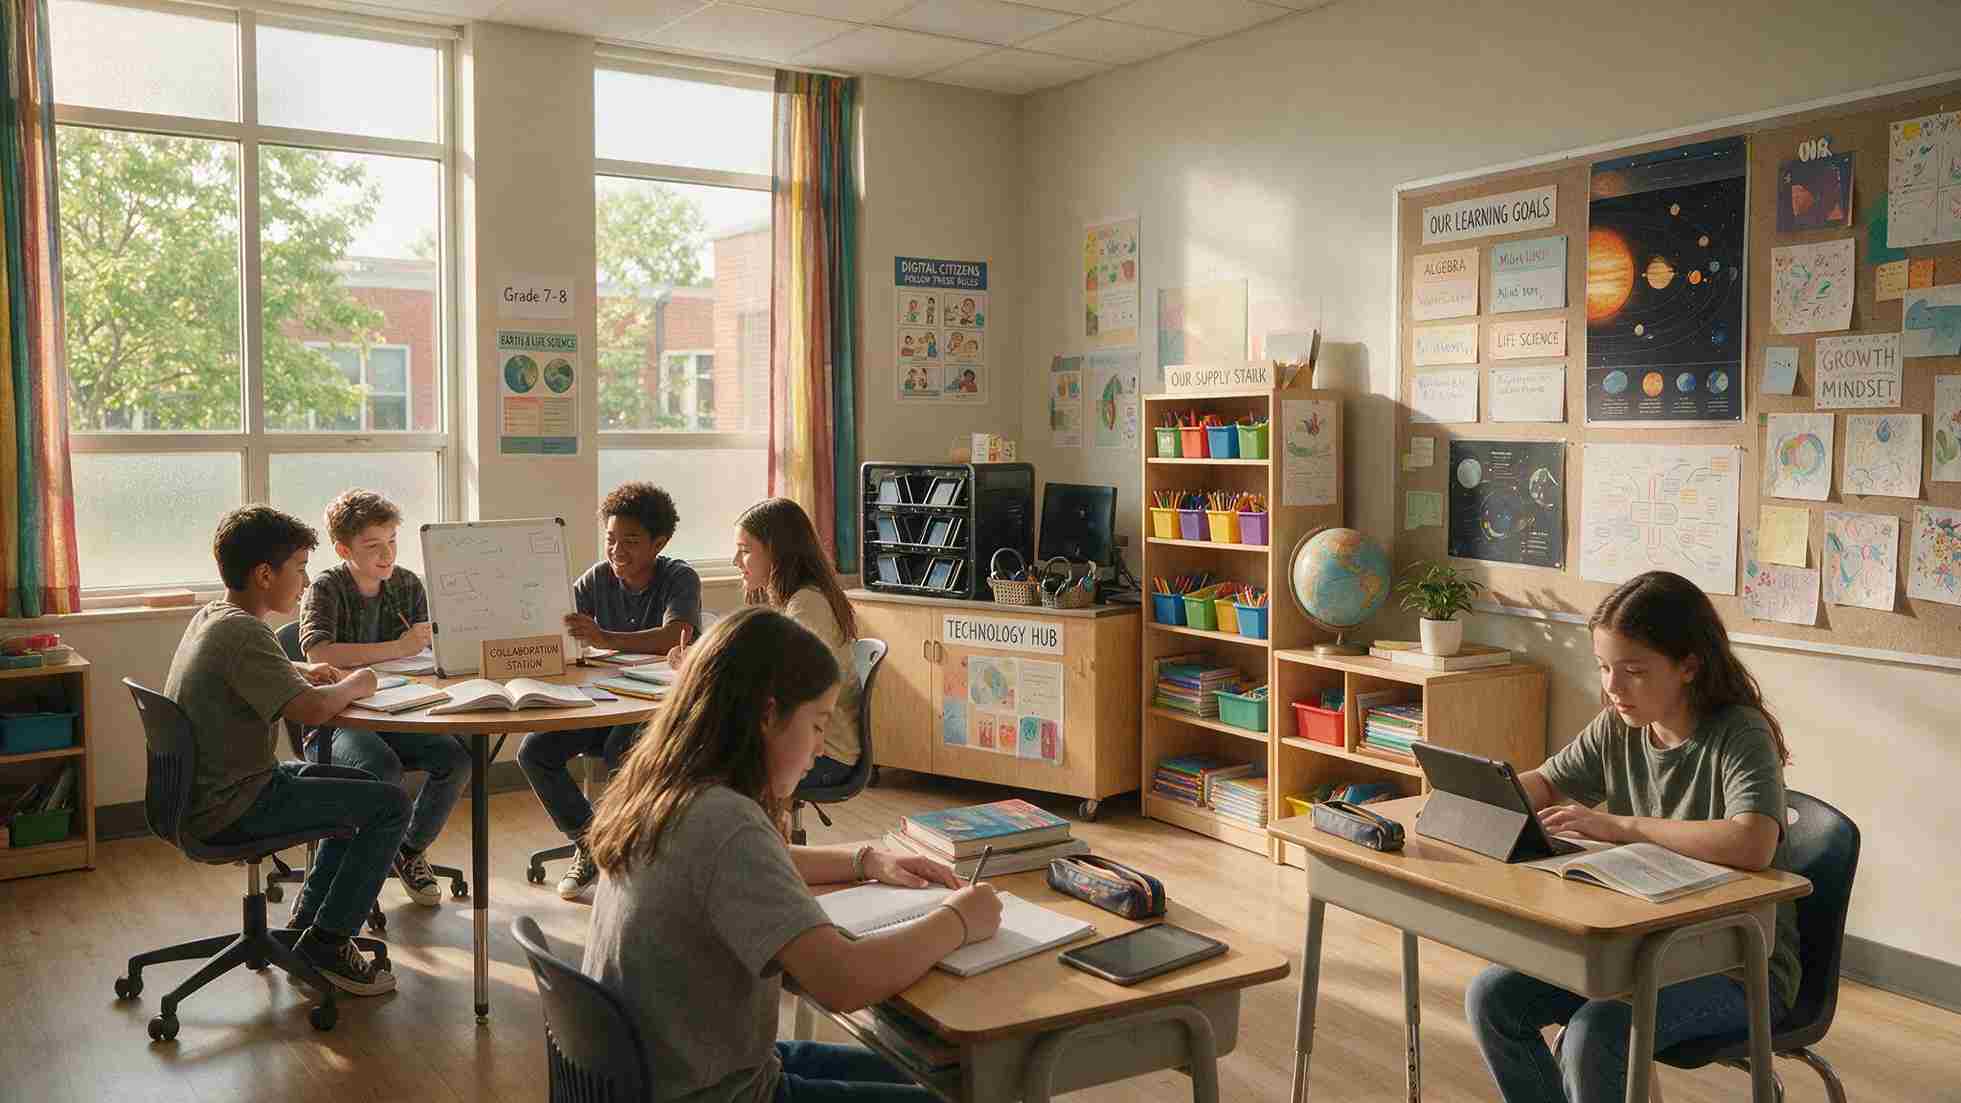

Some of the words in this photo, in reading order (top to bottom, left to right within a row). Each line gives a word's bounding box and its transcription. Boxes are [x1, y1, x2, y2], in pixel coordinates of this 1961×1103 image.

[1429, 214, 1453, 234] OUR
[1455, 202, 1508, 232] LEARNING
[1511, 196, 1551, 220] GOALS
[901, 260, 938, 274] DIGITAL
[938, 263, 980, 277] CITIZENS
[1424, 258, 1466, 275] ALGEBRA
[503, 287, 540, 304] Grade
[1497, 333, 1516, 348] LIFE
[1519, 331, 1559, 347] SCIENCE
[1821, 347, 1896, 372] GROWTH
[1171, 371, 1192, 386] OUR
[1195, 369, 1231, 386] SUPPLY
[1821, 379, 1896, 399] MINDSET
[946, 619, 1026, 645] TECHNOLOGY
[1031, 626, 1057, 647] HUB
